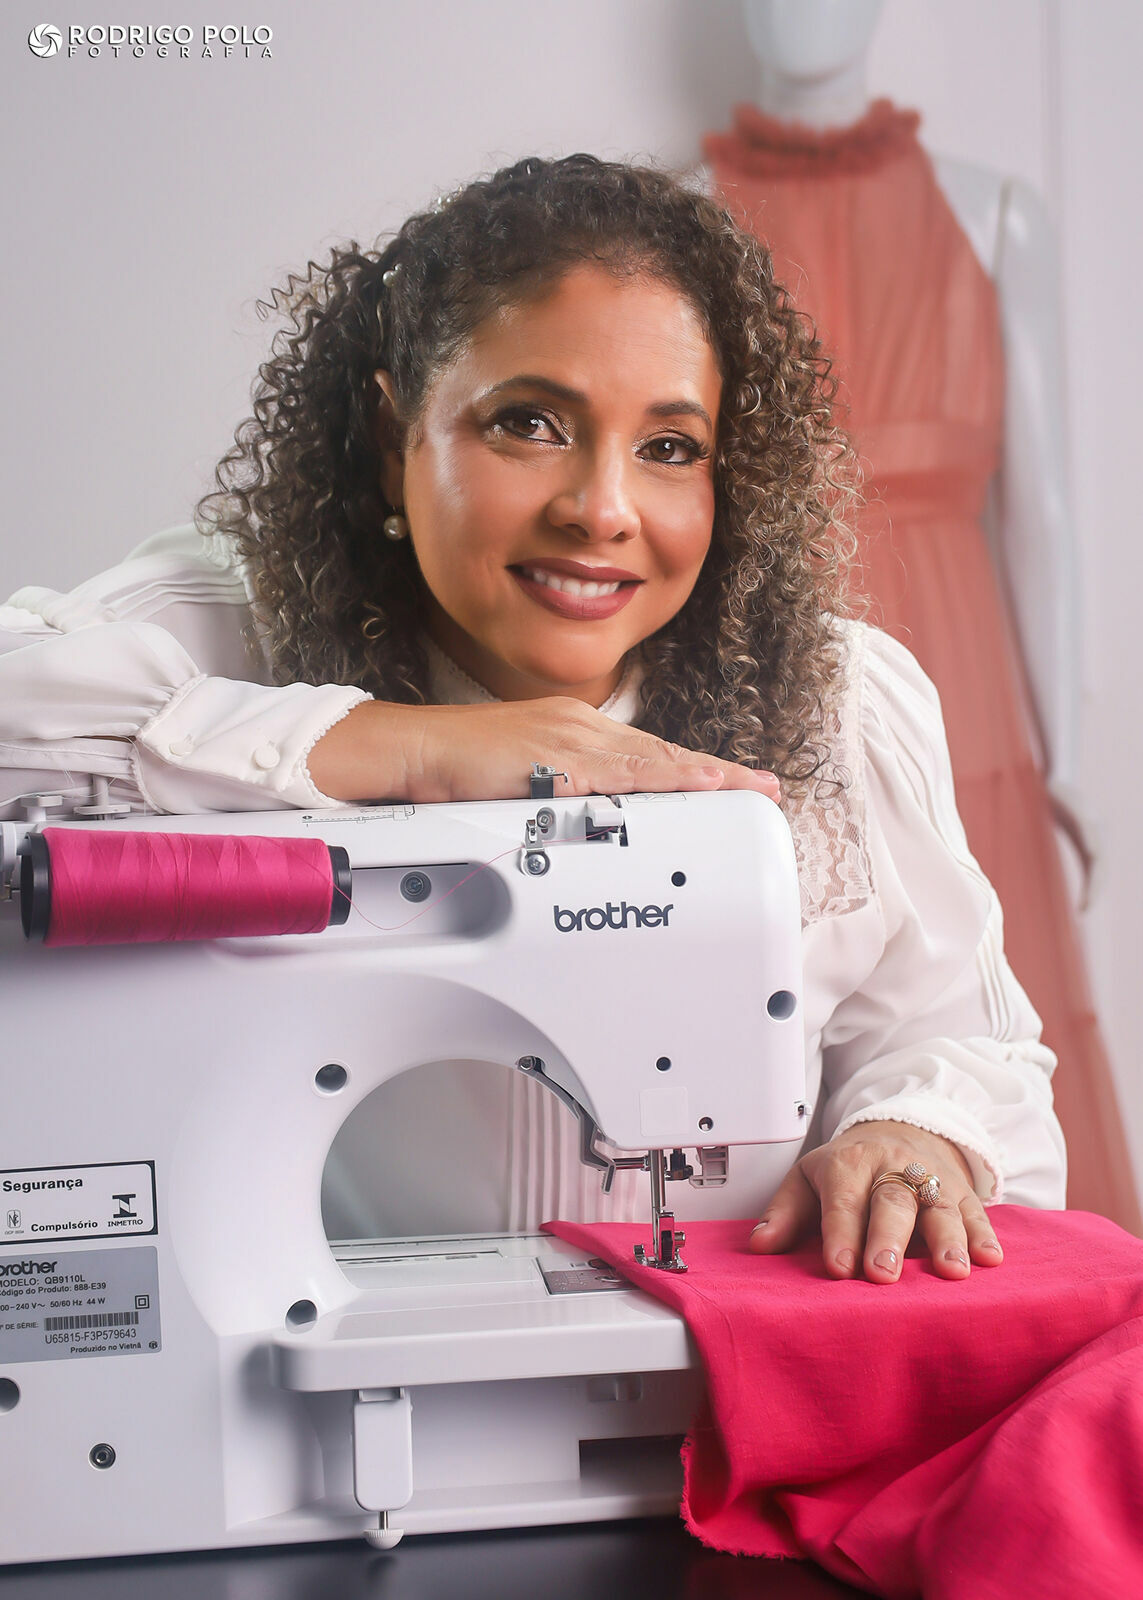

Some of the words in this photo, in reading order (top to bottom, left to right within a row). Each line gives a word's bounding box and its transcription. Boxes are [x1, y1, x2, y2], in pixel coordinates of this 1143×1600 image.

[553, 901, 674, 933] brother
[3, 1178, 83, 1193] Segurança
[31, 1220, 98, 1232] Compulsório
[108, 1219, 143, 1227] INMETRO
[0, 1278, 39, 1287] ODELO:
[45, 1275, 85, 1284] QB9110L
[0, 1289, 23, 1297] ódigo
[38, 1285, 72, 1293] Produto:
[74, 1283, 106, 1291] 888-E39
[50, 1300, 70, 1308] 50/60
[45, 1328, 136, 1344] U65815-F3P579643
[70, 1345, 106, 1353] Produzido
[119, 1342, 141, 1350] Vietnã
